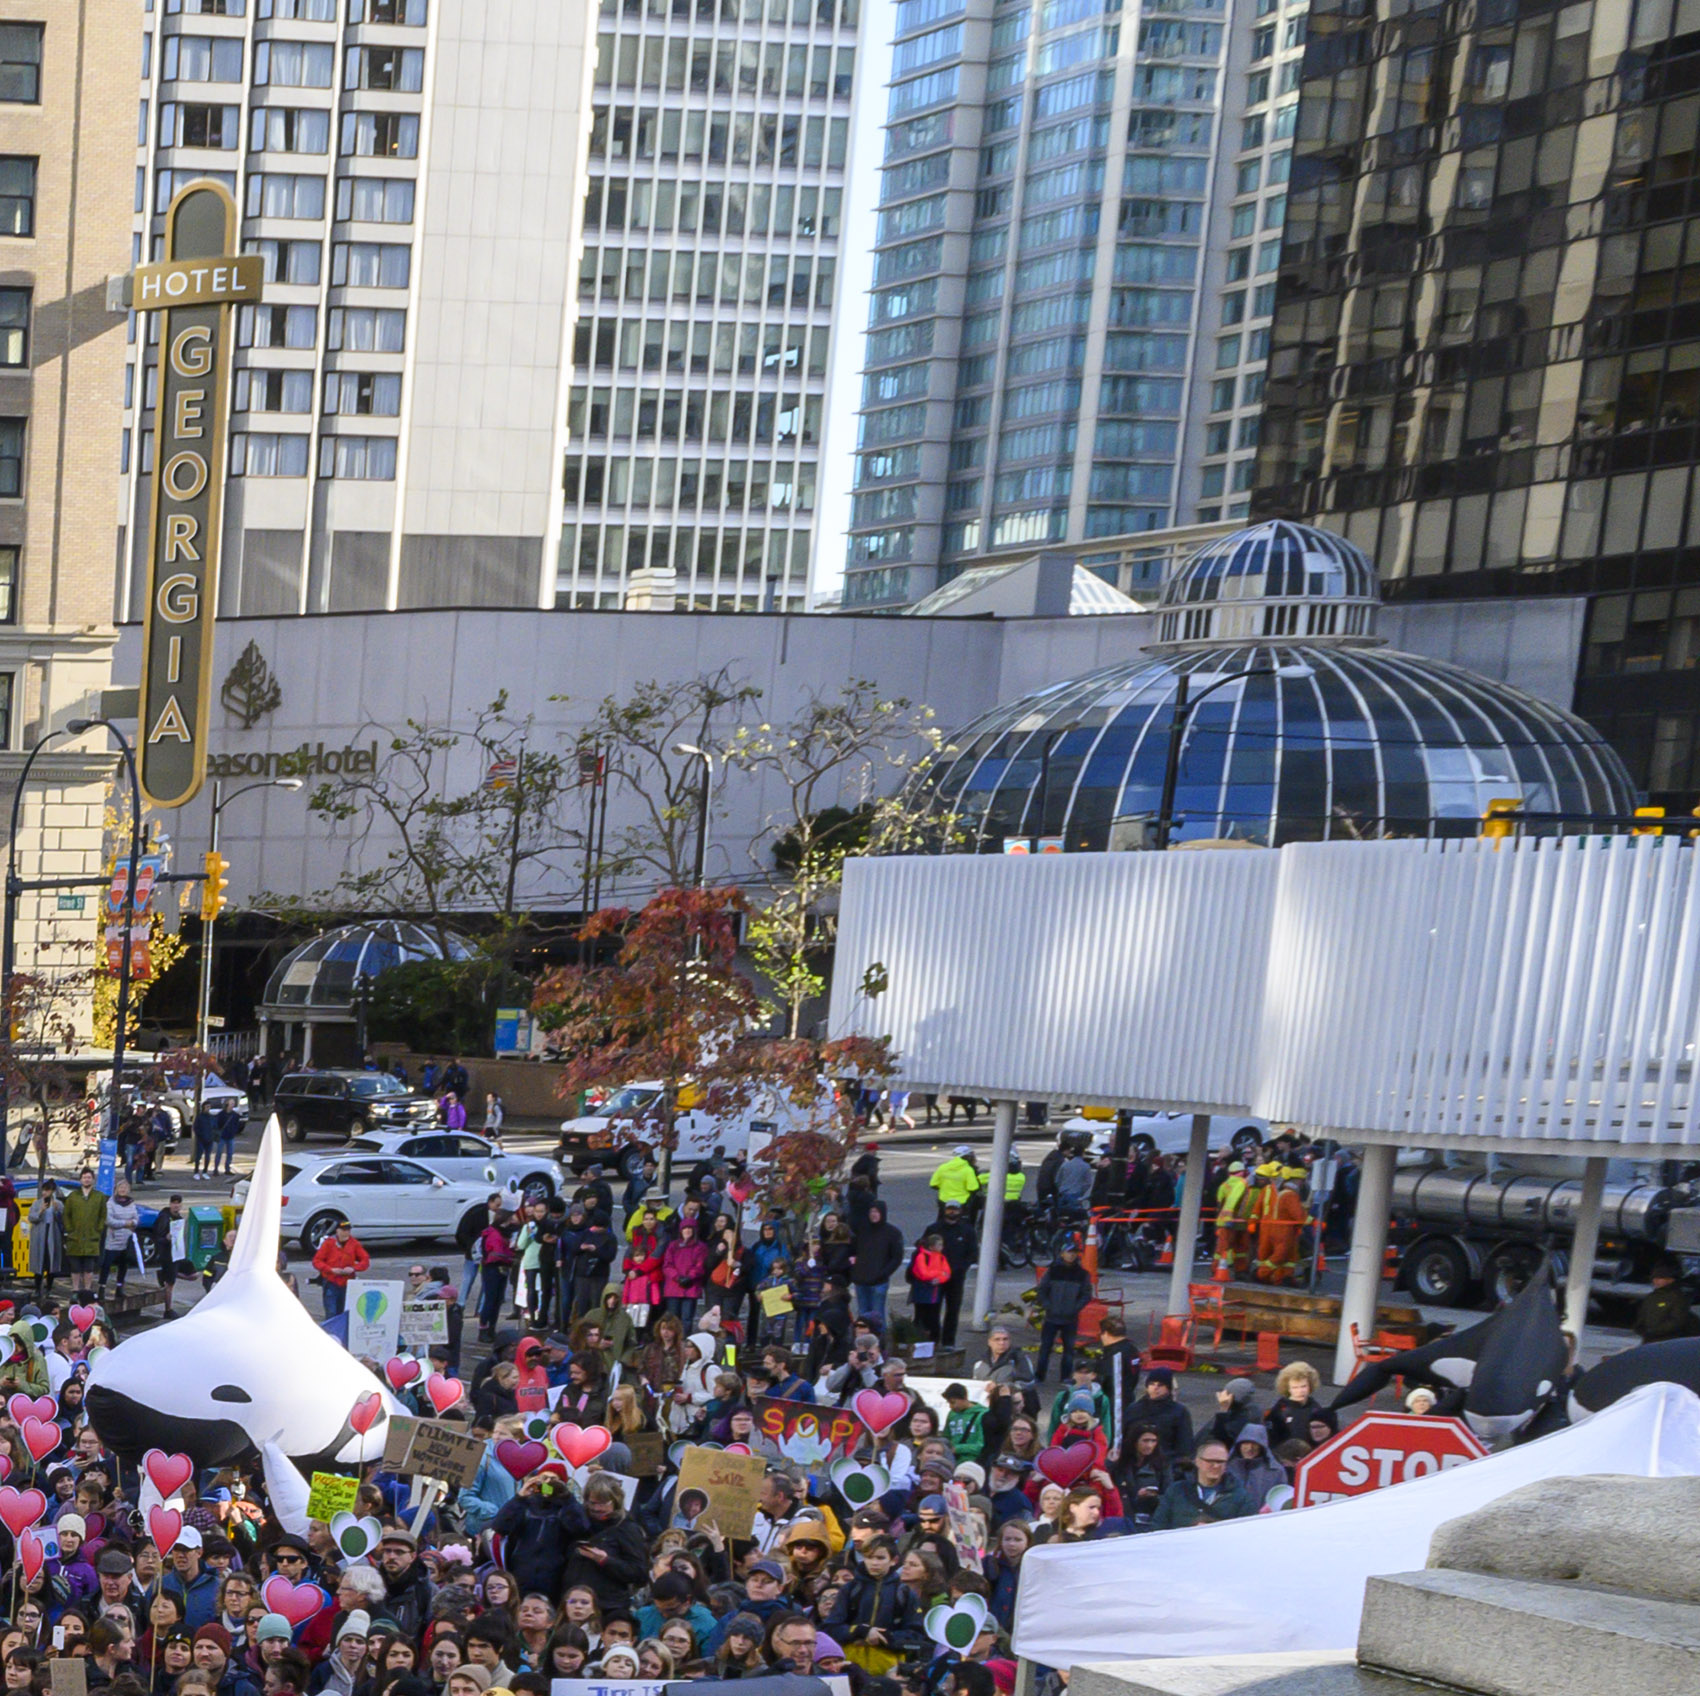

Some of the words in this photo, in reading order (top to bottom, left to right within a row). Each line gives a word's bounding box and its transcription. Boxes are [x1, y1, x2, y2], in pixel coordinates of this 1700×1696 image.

[141, 265, 247, 300] HOTEL
[148, 325, 213, 744] GEORGIA
[206, 750, 299, 778] easons
[300, 741, 378, 775] Hotel
[416, 1422, 480, 1451] CLIMATE
